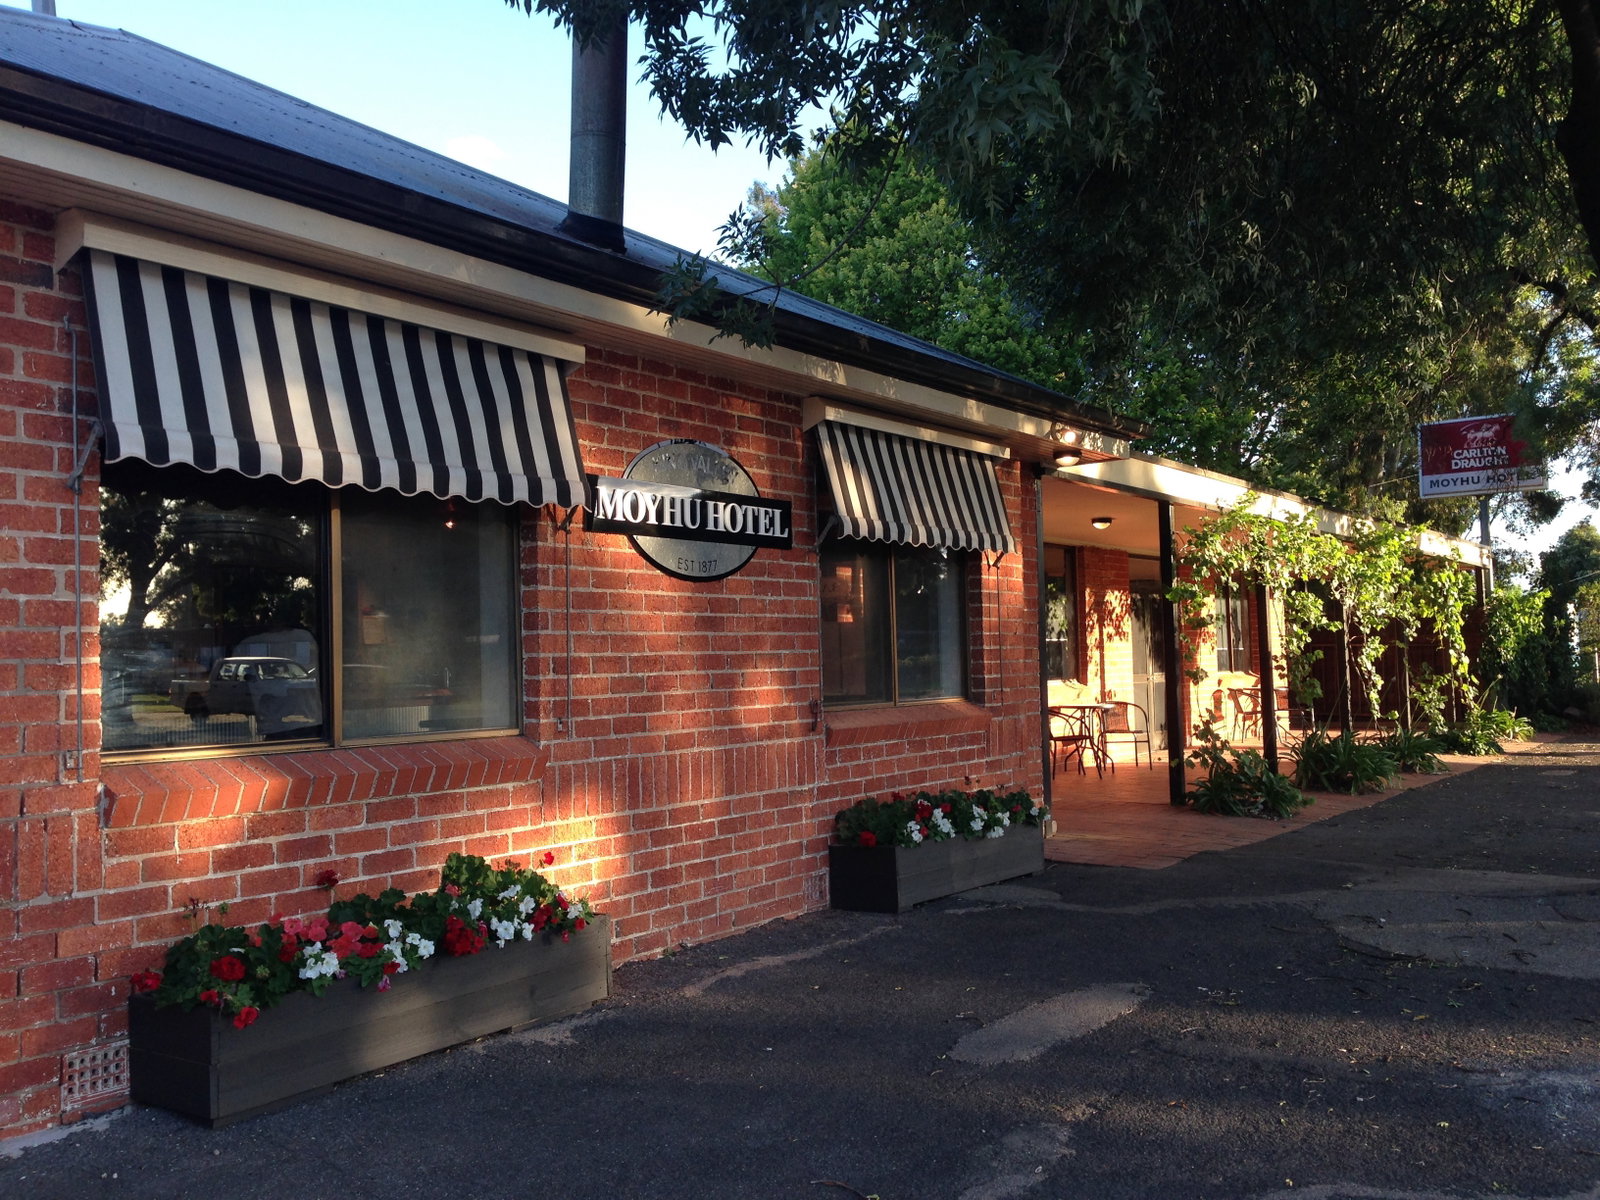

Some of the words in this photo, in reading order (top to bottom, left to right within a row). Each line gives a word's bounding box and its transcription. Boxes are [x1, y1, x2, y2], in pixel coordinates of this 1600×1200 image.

[1429, 475, 1481, 489] MOYHU
[1486, 471, 1537, 483] HOT
[593, 486, 702, 530] MOYHU
[705, 499, 789, 539] HOTEL
[677, 557, 695, 573] EST
[698, 559, 718, 574] 1877
